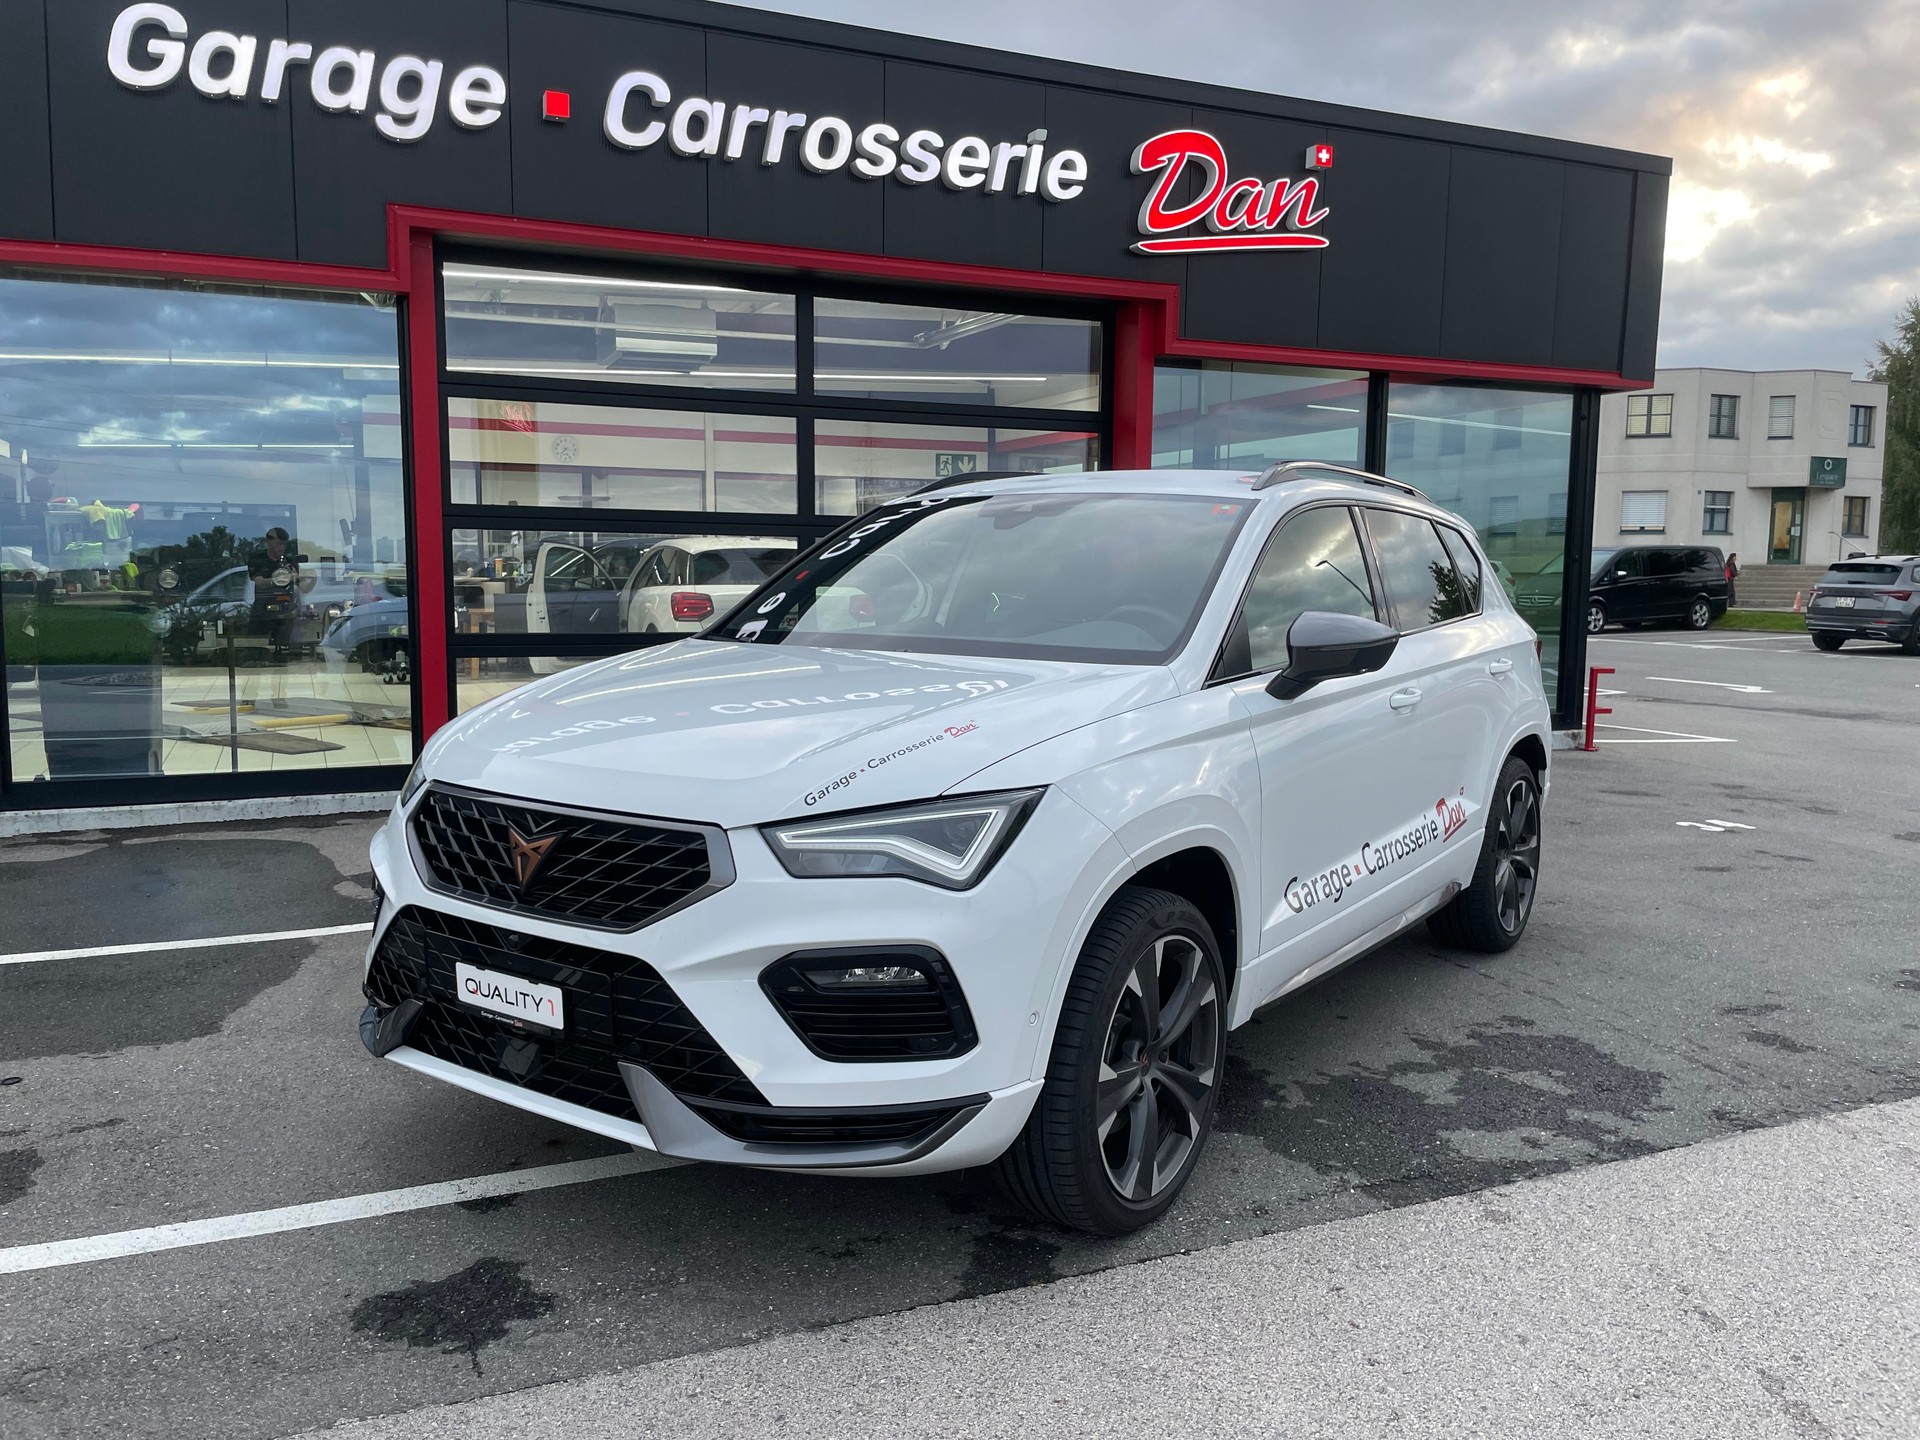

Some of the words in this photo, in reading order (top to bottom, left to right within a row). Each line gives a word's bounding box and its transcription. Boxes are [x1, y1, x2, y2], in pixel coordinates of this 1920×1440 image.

[107, 2, 507, 143] Garage
[603, 71, 1088, 202] Carrosserie
[1129, 128, 1330, 240] Dan
[804, 770, 857, 806] Garage
[867, 733, 944, 769] Carrosserie
[943, 722, 980, 738] Dan
[1284, 864, 1352, 913] Garage
[1361, 814, 1439, 875] Carrosserie
[1436, 797, 1467, 841] Dan
[465, 977, 543, 1012] QUALITY
[547, 998, 555, 1017] 1
